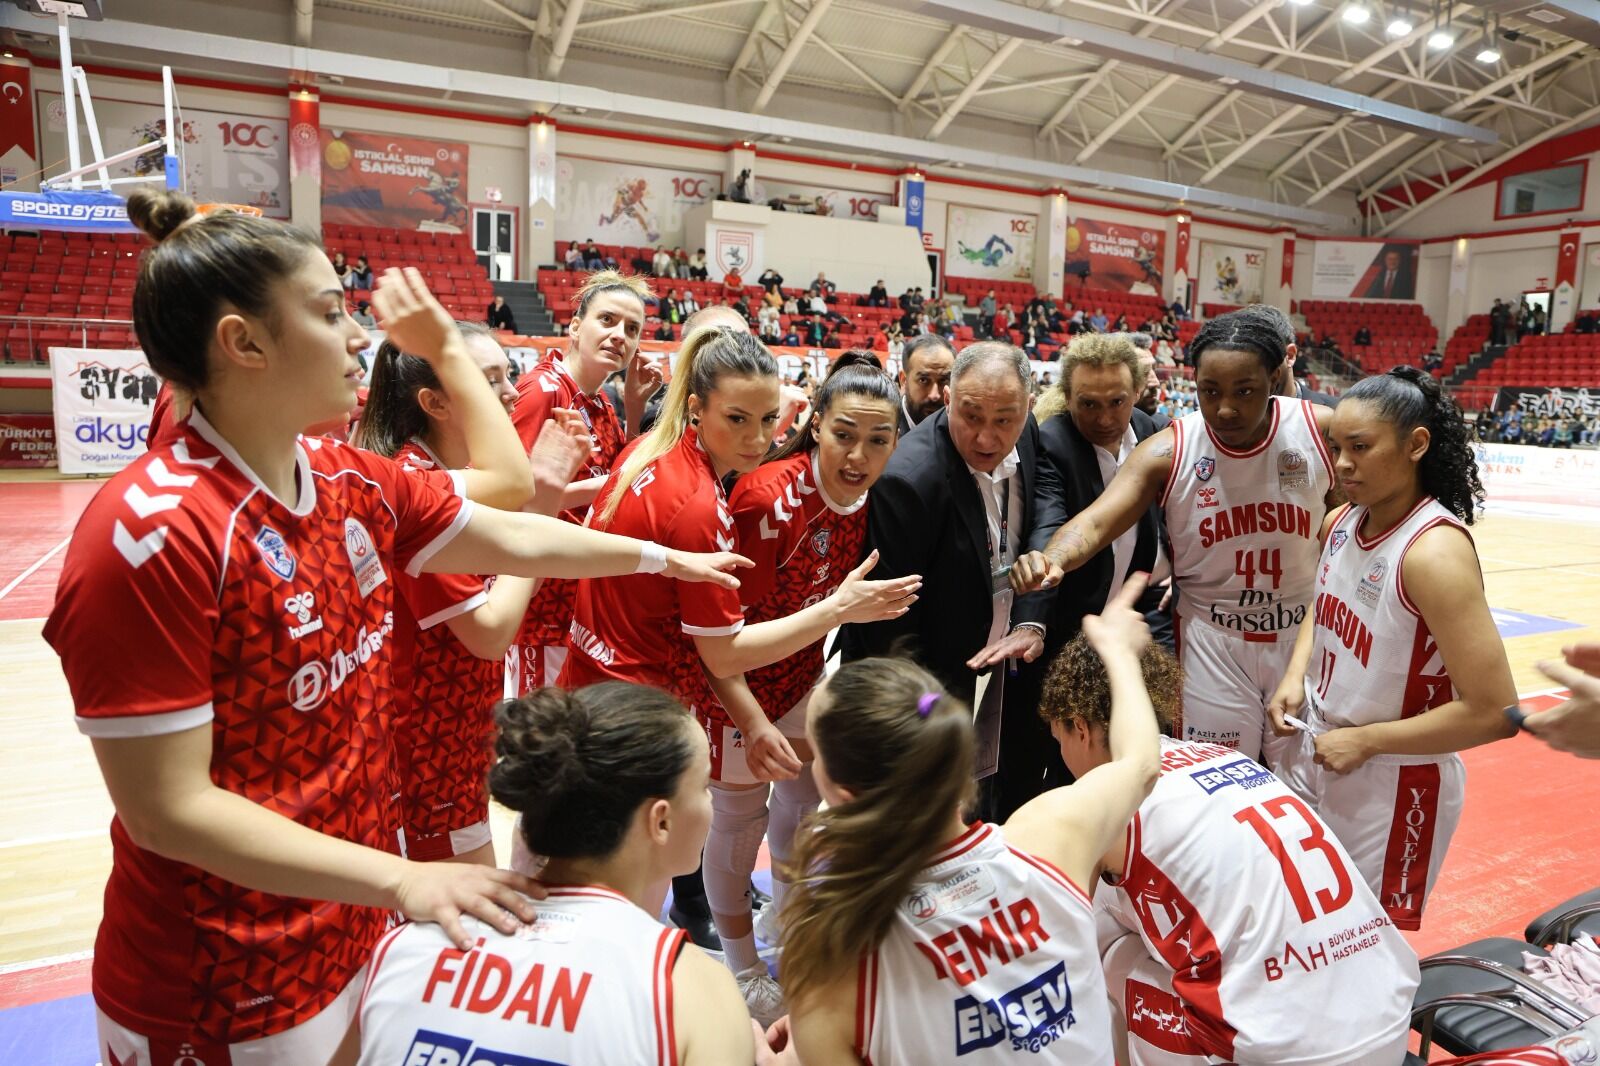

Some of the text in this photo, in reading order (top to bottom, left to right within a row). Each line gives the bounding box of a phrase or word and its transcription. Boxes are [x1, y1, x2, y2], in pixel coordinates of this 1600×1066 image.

[360, 160, 430, 178] SAMSUN
[1089, 242, 1135, 258] SAMSUN
[1199, 502, 1311, 549] SAMSUN
[1236, 548, 1283, 590] 44
[1211, 602, 1306, 632] kasaba
[1239, 589, 1282, 609] my
[1315, 592, 1373, 669] AMSUN
[1197, 730, 1240, 738] AZİZ ATİK
[1241, 774, 1277, 790] SİGORTA
[1233, 795, 1353, 924] 13
[1389, 787, 1428, 911] YÖNETİM
[1329, 928, 1357, 948] BÜYÜK
[421, 937, 593, 1033] FİDAN
[1012, 1011, 1076, 1054] SİGORTA
